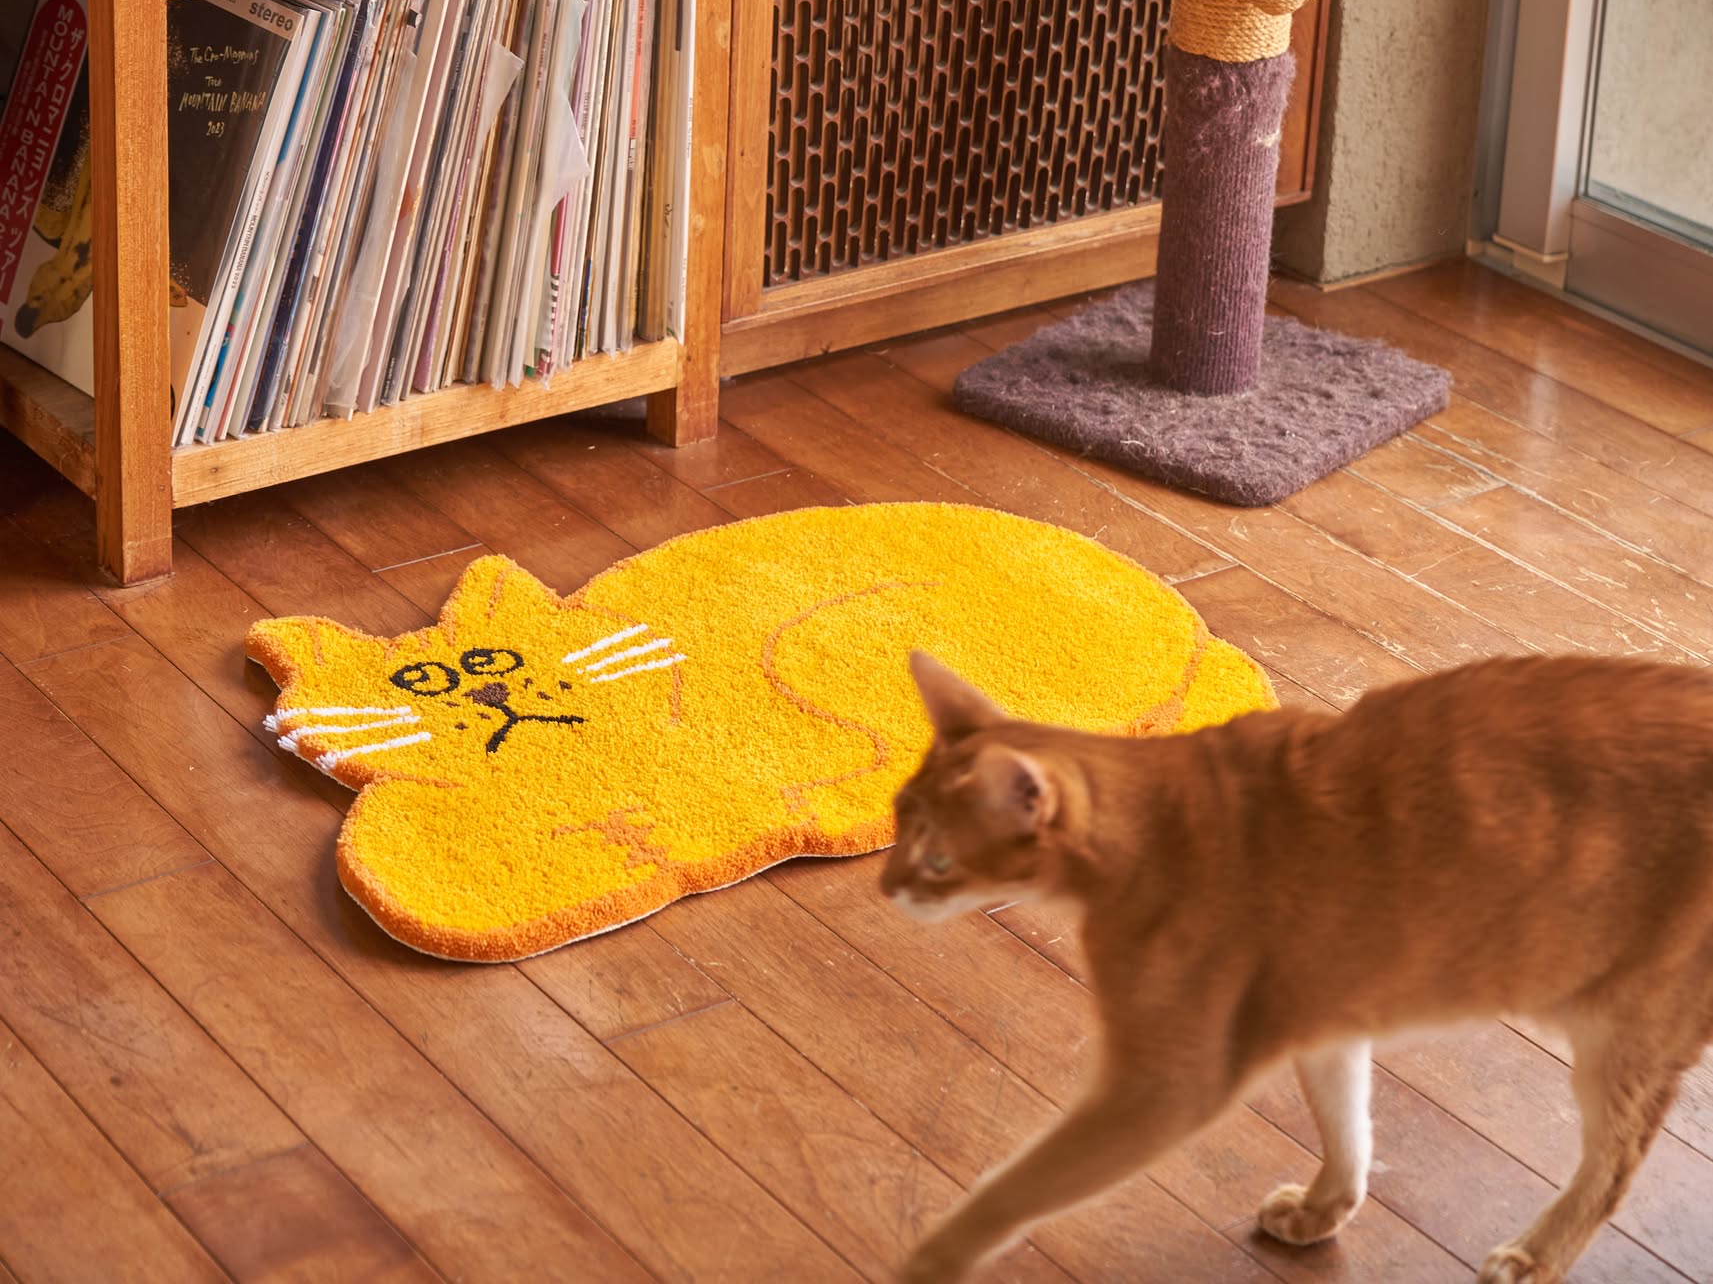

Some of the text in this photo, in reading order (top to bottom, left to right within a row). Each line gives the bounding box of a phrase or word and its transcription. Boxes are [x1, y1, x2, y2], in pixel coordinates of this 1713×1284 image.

[249, 1, 294, 32] stereo
[26, 4, 74, 127] MOUNTAIN
[0, 127, 34, 221] BANANA
